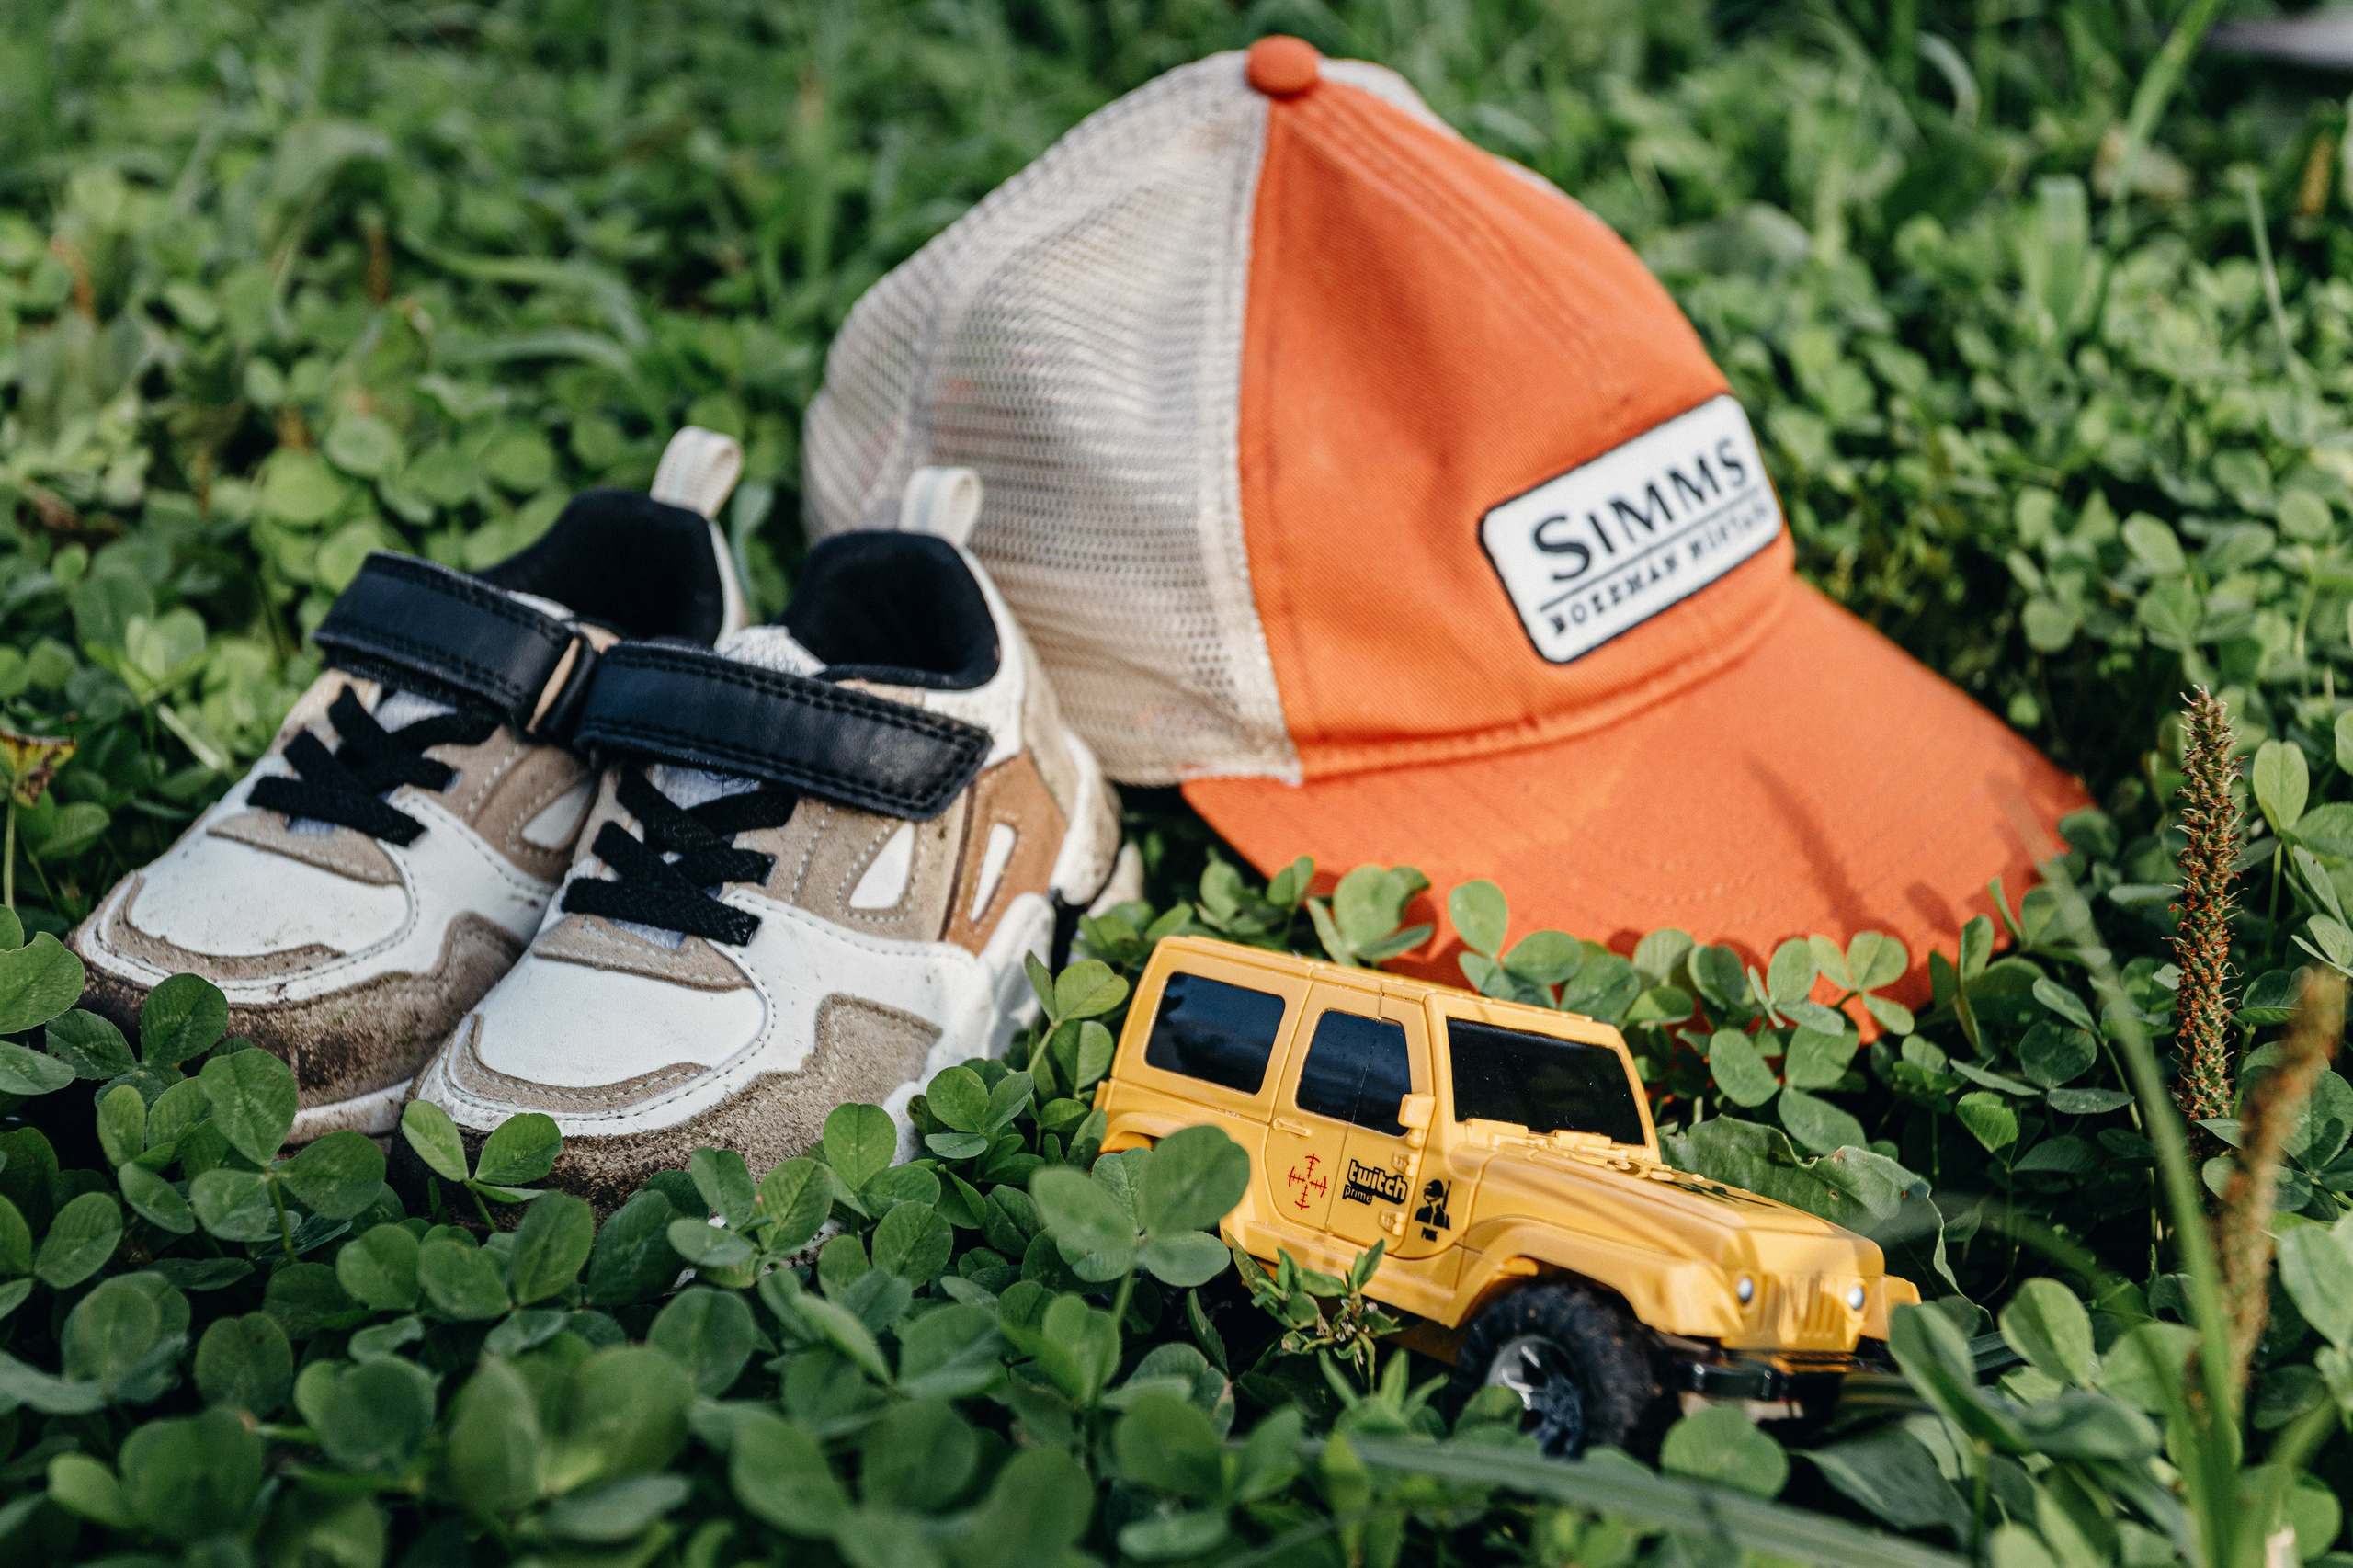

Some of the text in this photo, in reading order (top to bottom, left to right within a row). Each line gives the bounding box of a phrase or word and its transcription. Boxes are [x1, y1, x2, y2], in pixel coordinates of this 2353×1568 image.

[1533, 438, 1745, 581] SIMMS
[1344, 1186, 1372, 1204] prime
[1347, 1160, 1407, 1202] twitch
